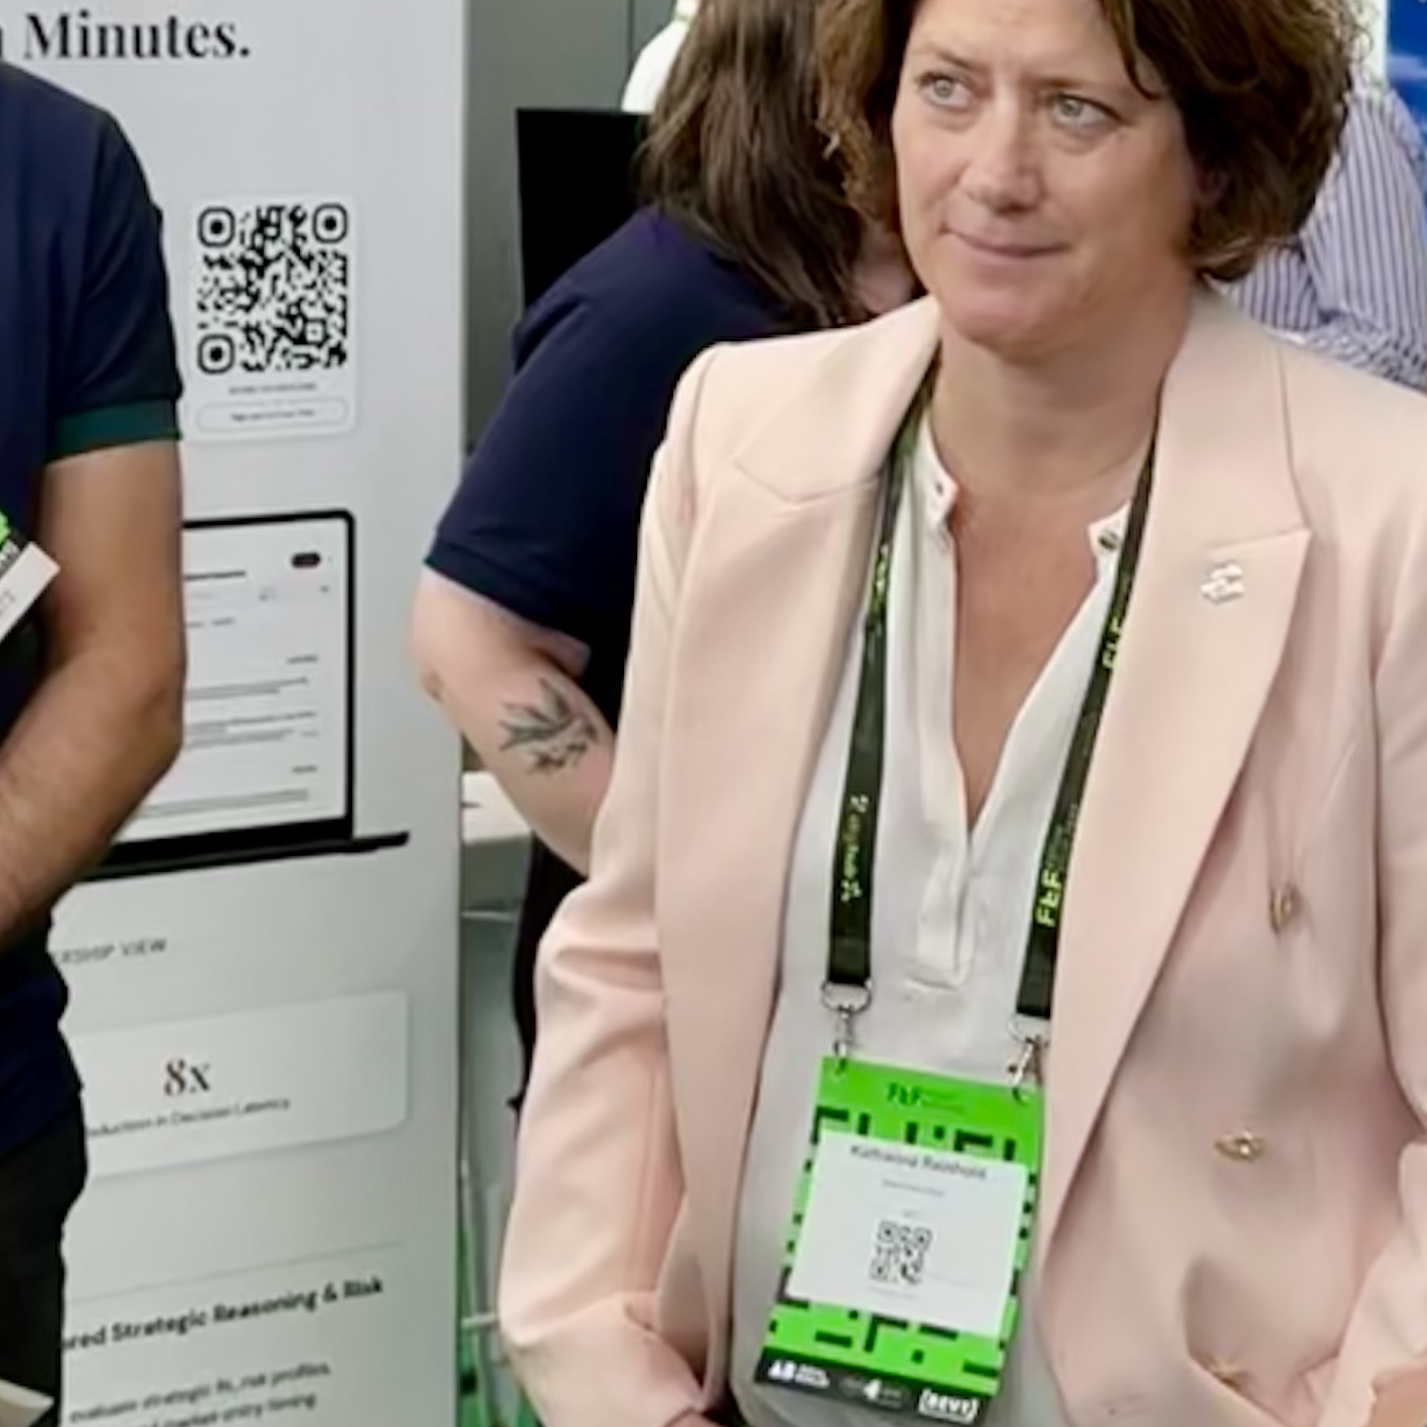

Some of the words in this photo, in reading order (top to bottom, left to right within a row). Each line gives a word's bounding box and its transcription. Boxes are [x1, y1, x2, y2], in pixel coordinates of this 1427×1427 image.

[25, 8, 251, 60] Minutes.
[164, 1058, 210, 1097] 8x
[111, 1307, 208, 1343] Strategic
[213, 1288, 317, 1322] Reasoning
[323, 1282, 338, 1303] &
[343, 1275, 384, 1298] Risk
